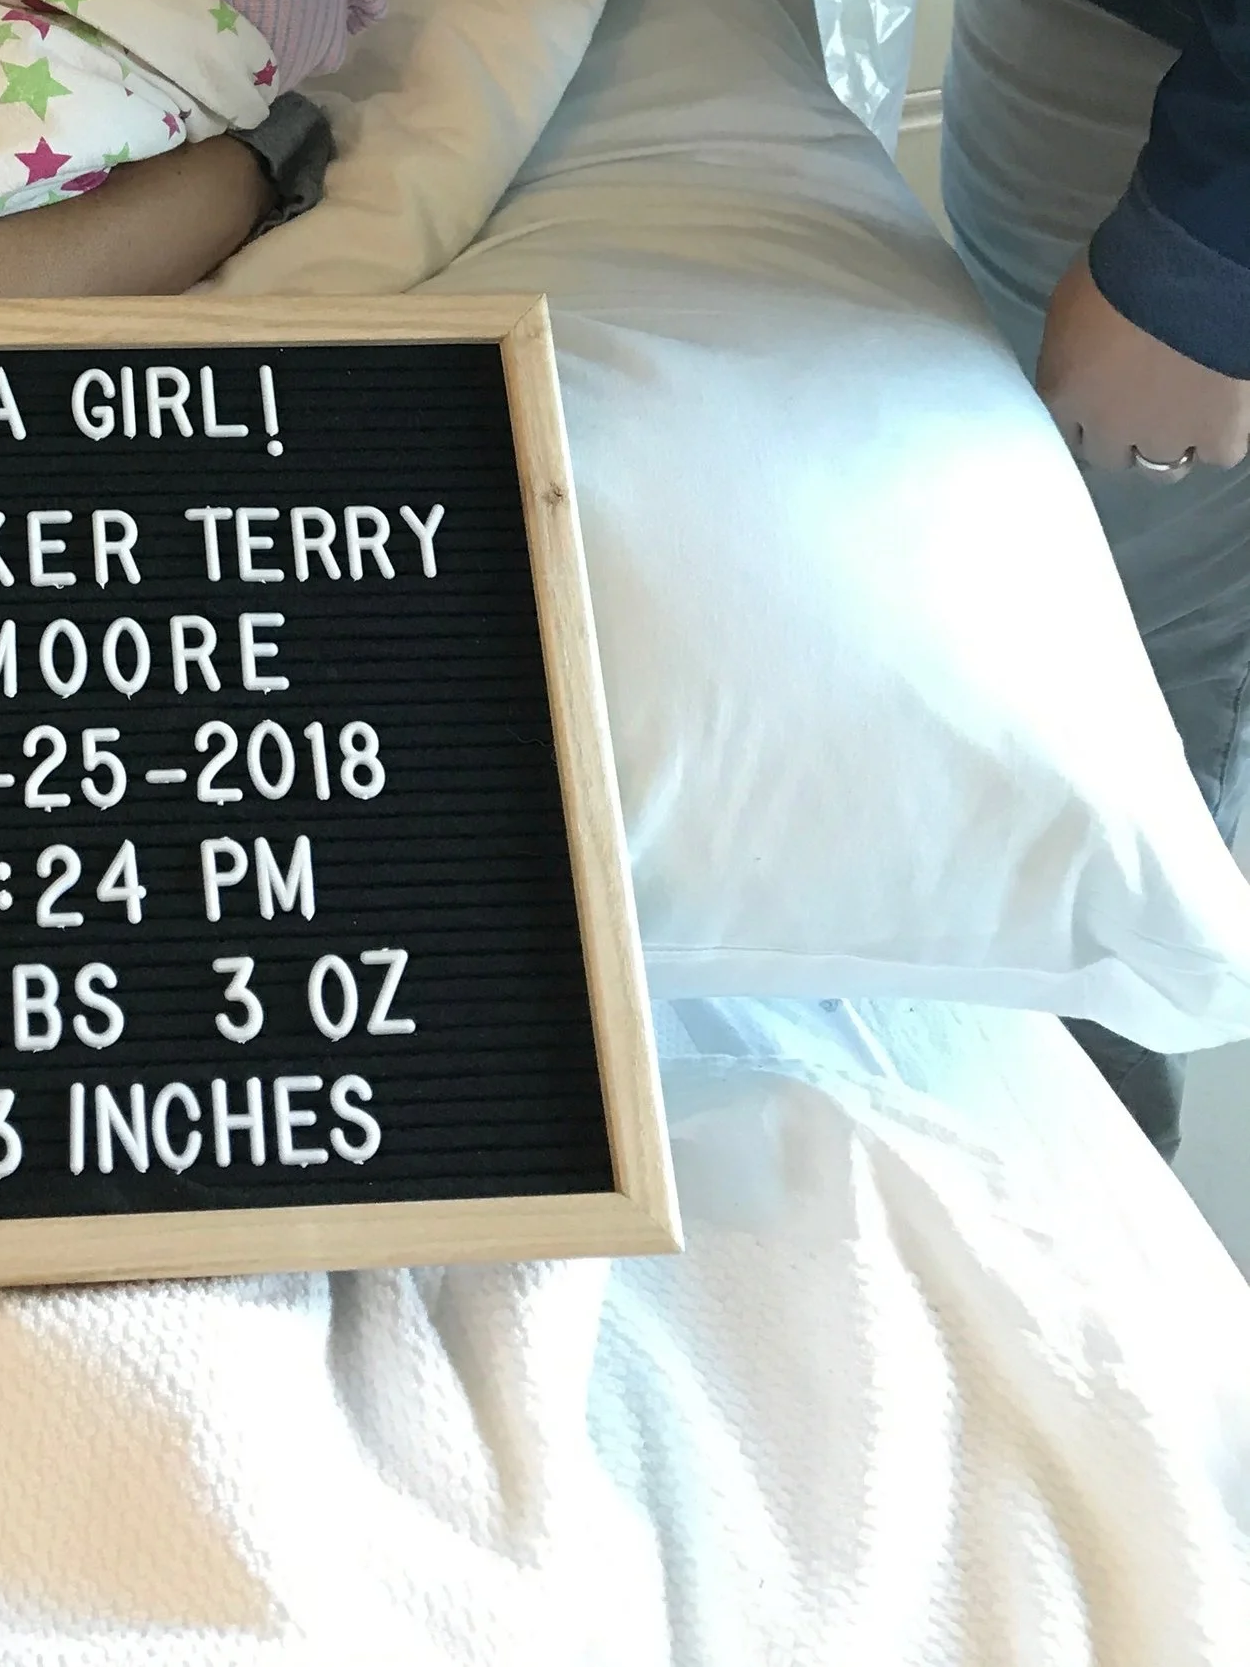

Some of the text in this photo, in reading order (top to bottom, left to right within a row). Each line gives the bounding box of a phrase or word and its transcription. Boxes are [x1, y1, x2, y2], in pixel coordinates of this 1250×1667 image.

[72, 365, 284, 457] GIRL!
[185, 503, 445, 584] TERRY
[201, 834, 316, 923] PM
[213, 956, 264, 1045] 3
[308, 947, 416, 1043] OZ
[70, 1074, 382, 1176] INCHES
